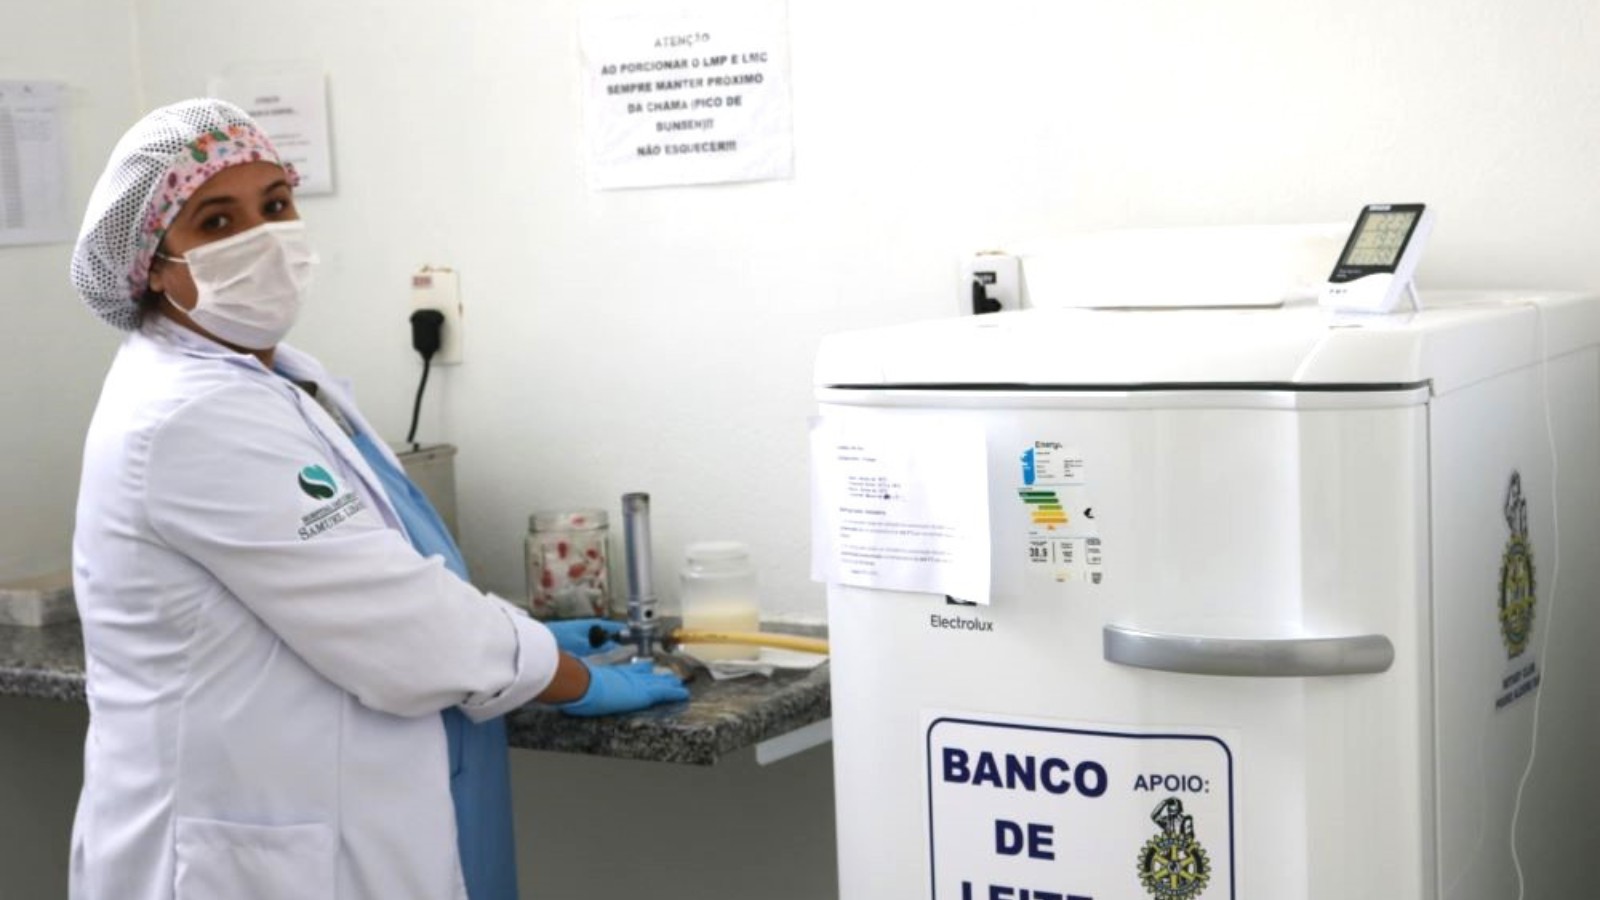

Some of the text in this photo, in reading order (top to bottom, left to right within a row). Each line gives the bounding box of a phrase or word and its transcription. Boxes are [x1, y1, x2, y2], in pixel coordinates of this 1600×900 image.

[601, 52, 767, 75] AO PORCIONAR O LMP E LMC
[607, 82, 652, 95] SEMPRE
[655, 79, 703, 91] MANTER
[647, 100, 688, 112] CHAMA
[726, 95, 742, 107] DE
[637, 143, 661, 155] NÃO
[930, 613, 993, 632] Electrolux
[942, 747, 1108, 798] BANCO
[1133, 773, 1210, 793] APOIO:
[994, 819, 1055, 860] DE
